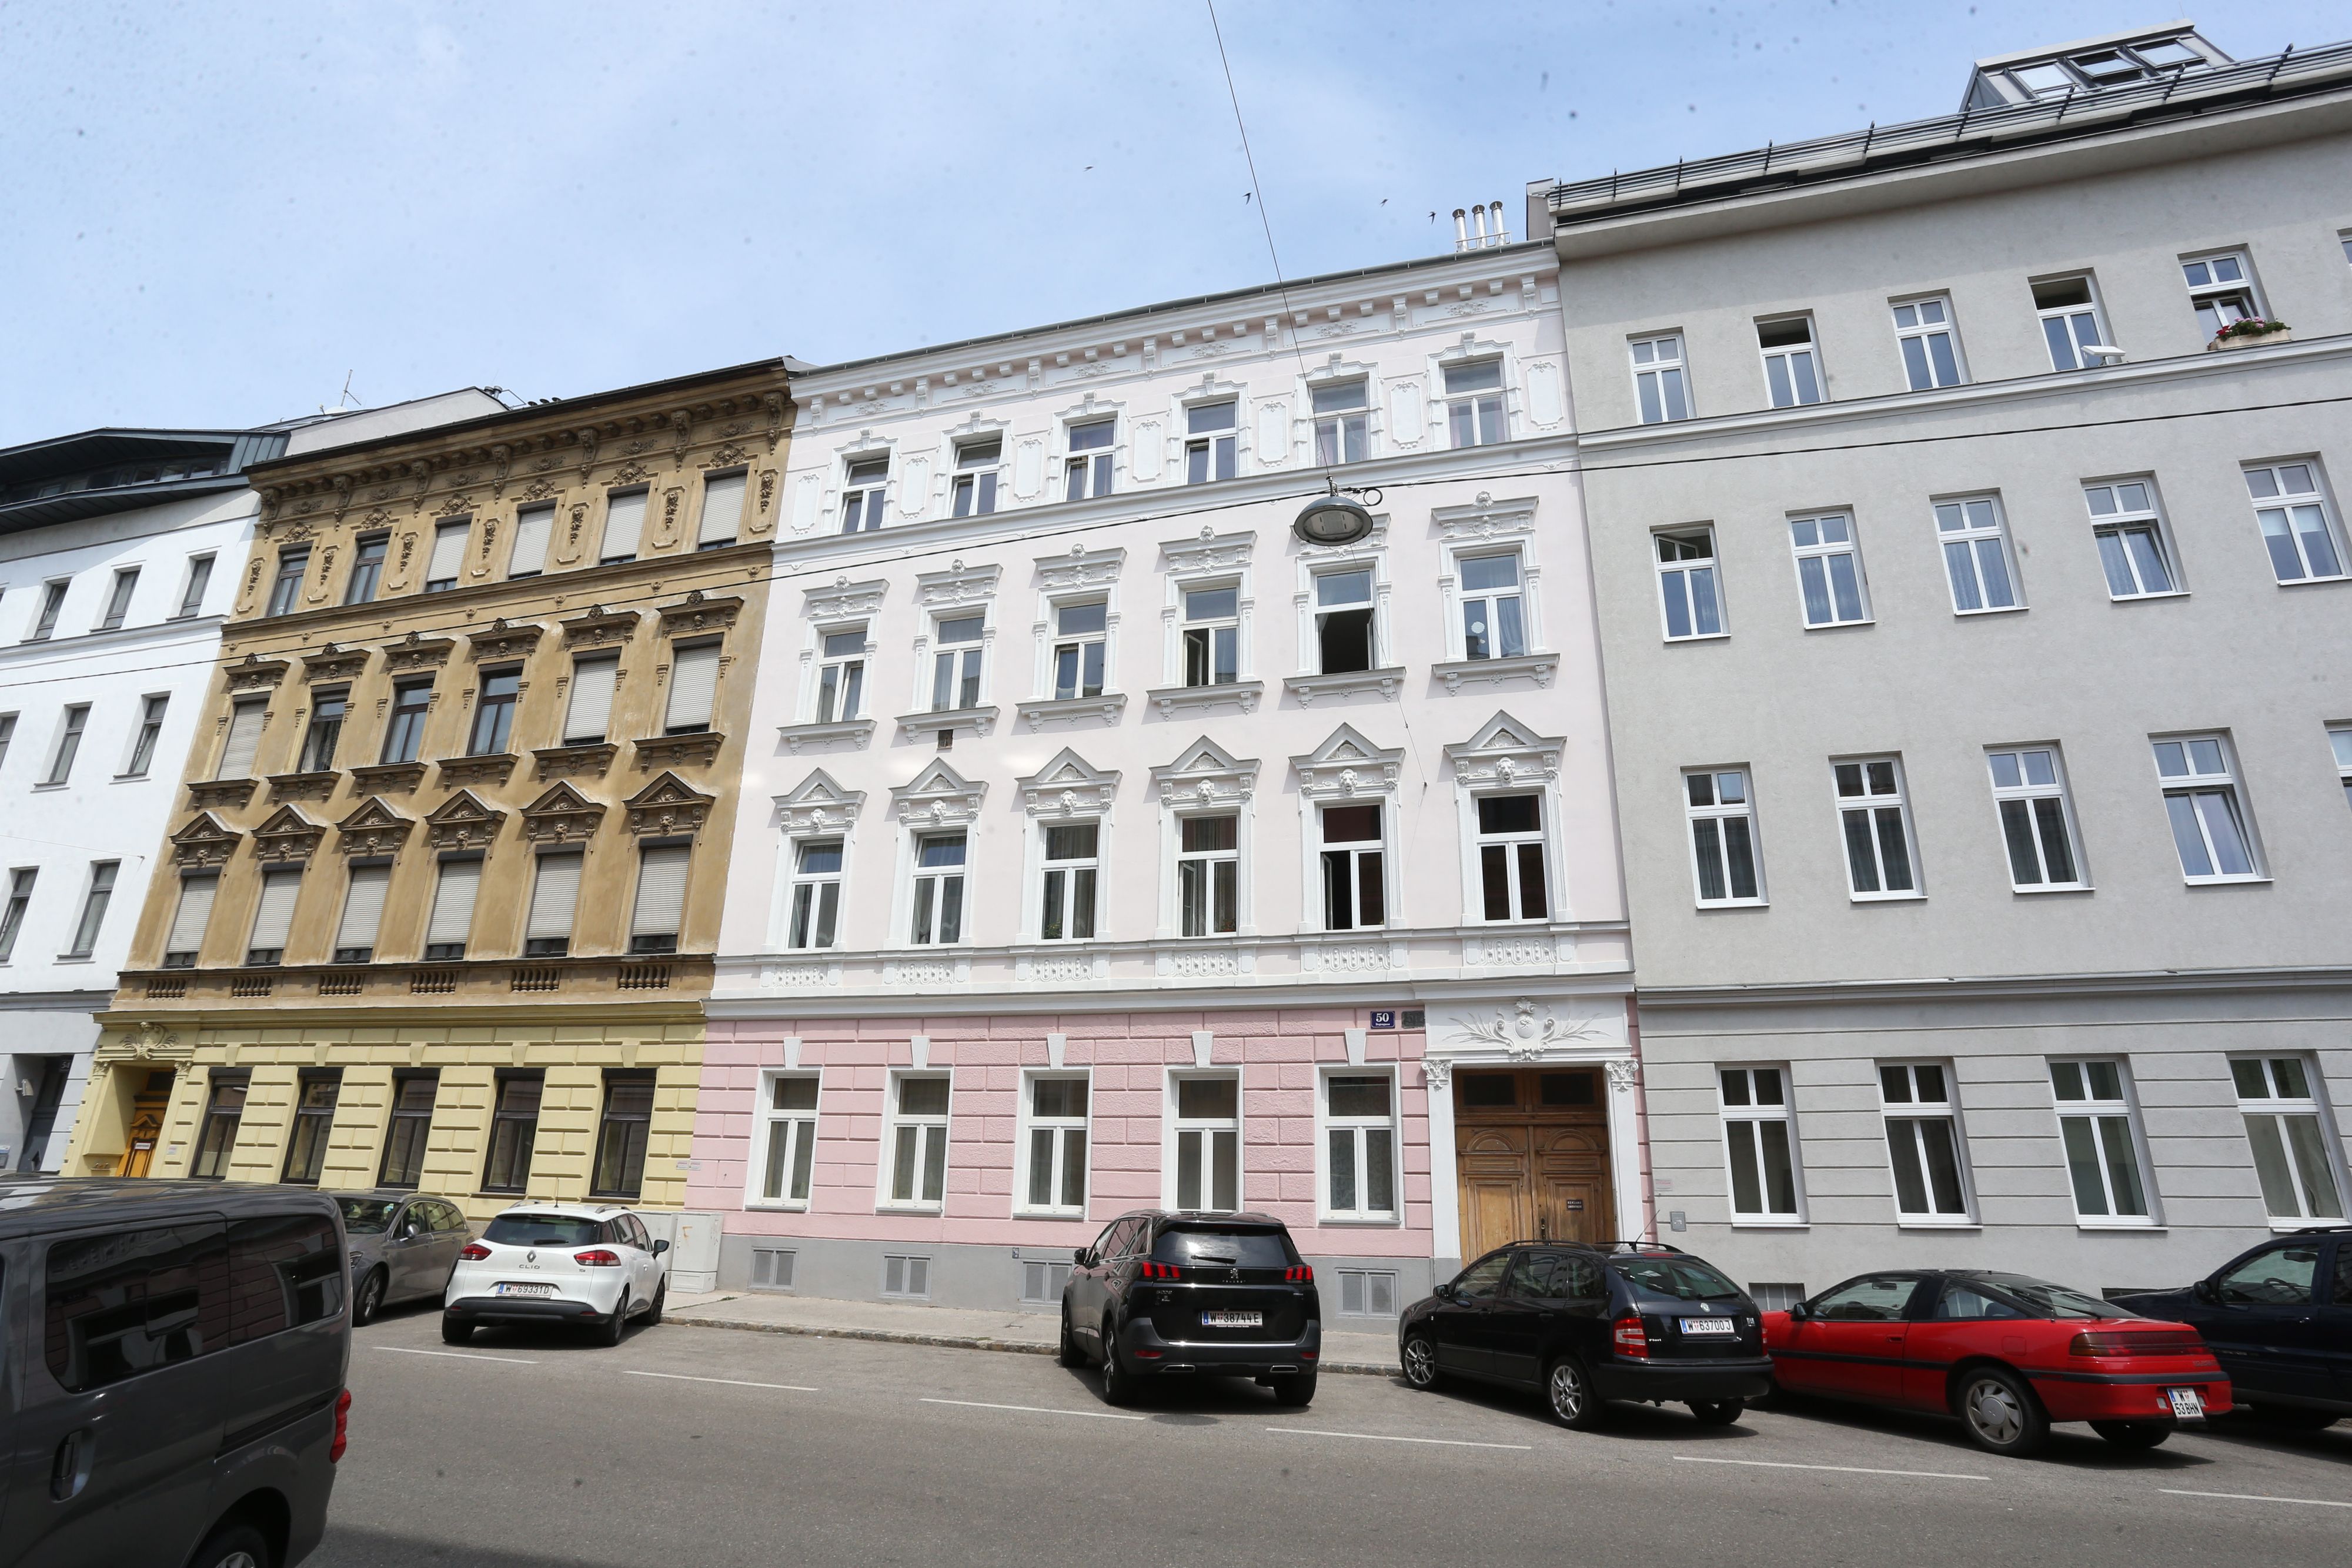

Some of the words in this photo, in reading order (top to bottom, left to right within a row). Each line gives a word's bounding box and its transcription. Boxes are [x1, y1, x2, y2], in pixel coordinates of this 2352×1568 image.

[1376, 1012, 1389, 1022] 50
[506, 1284, 512, 1292] W
[517, 1285, 550, 1294] 69331D
[1210, 1313, 1217, 1323] W
[1224, 1313, 1259, 1323] 38744E
[1687, 1320, 1693, 1331] W
[1699, 1320, 1731, 1330] 63700J
[2177, 1390, 2185, 1402] W
